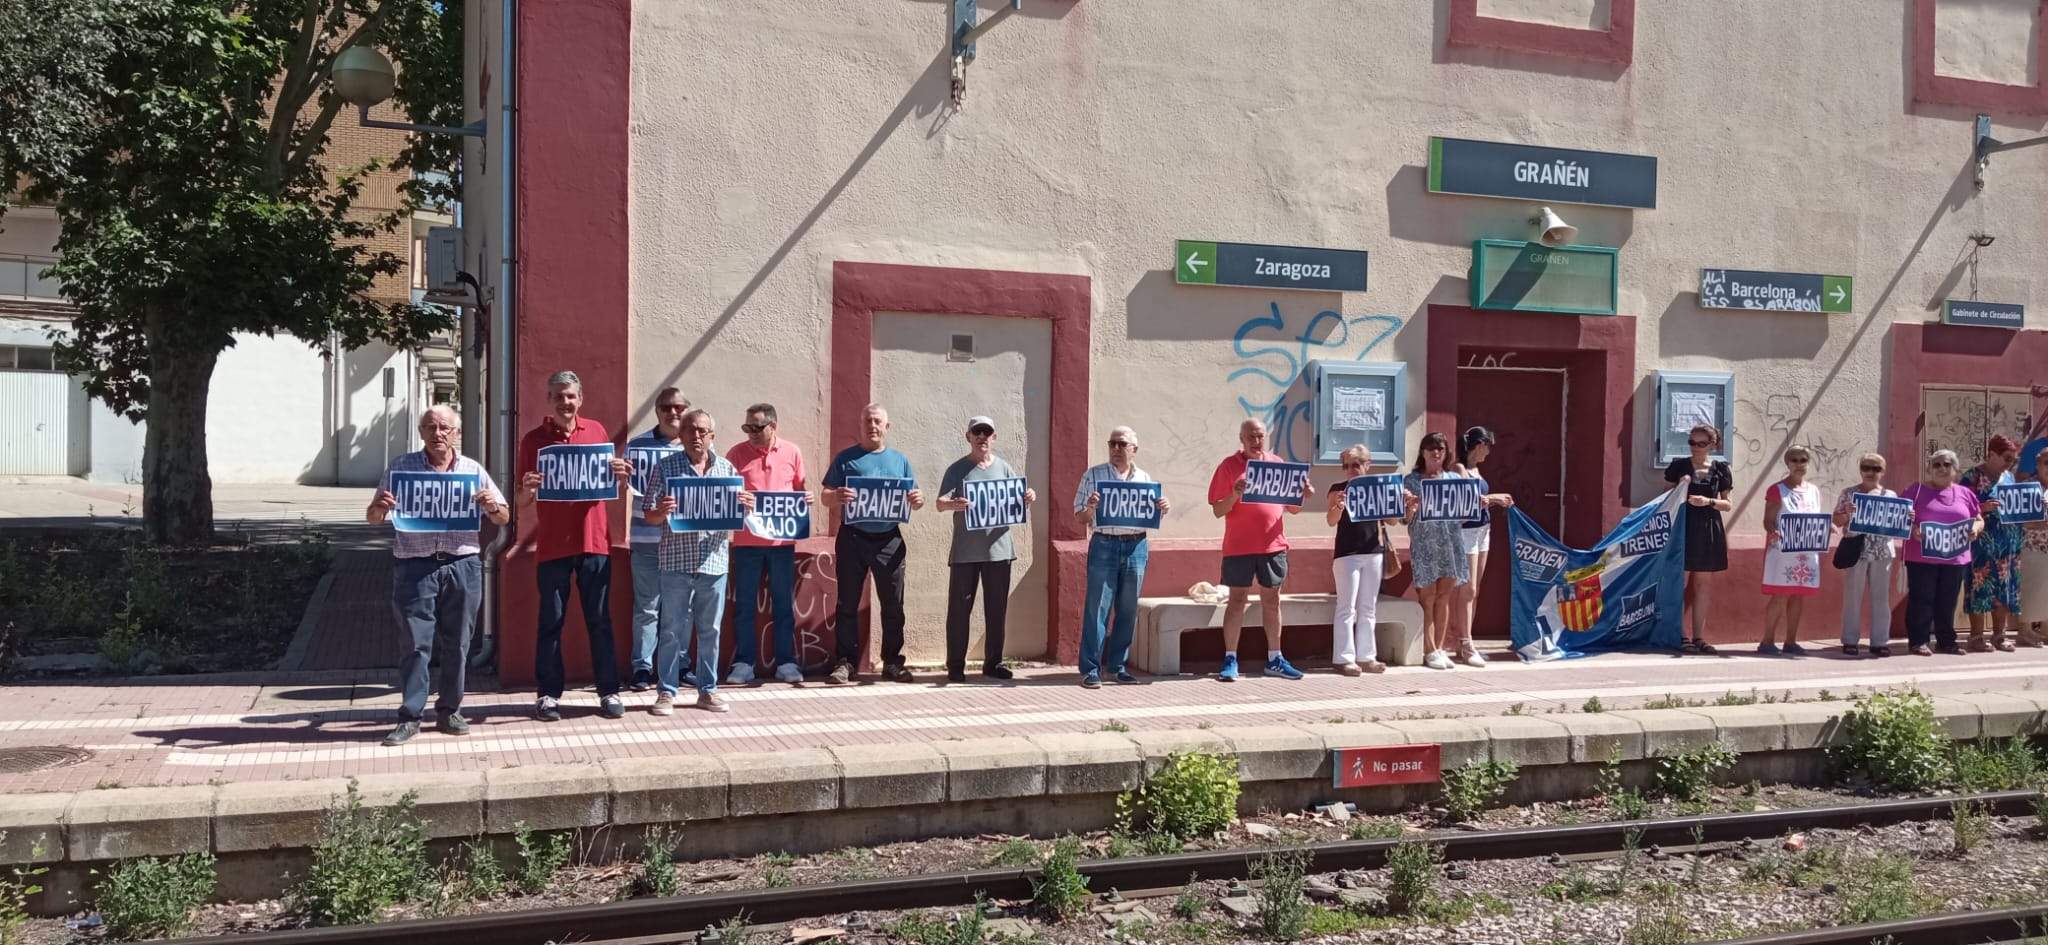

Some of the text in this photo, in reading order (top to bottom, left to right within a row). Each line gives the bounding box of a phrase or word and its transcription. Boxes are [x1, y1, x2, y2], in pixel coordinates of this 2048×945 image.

[1514, 159, 1589, 187] GRAÑÉN
[1255, 257, 1331, 280] Zaragoza
[1731, 282, 1796, 299] Barcelona
[1952, 308, 2021, 320] Gabinete de Circulación
[539, 452, 614, 491] TRAMACED
[1246, 466, 1307, 499] BARBUES
[394, 479, 477, 519] ALBERUELA
[671, 485, 743, 520] ALMUNIENTE
[753, 496, 808, 517] LBERO
[966, 479, 1024, 527] ROBRES
[1102, 487, 1154, 520] TORRES
[1421, 482, 1481, 518] VALFONDA
[1999, 487, 2042, 516] SODETO
[757, 516, 797, 537] BAJO
[1852, 497, 1911, 531] ALCUBIERRE
[1623, 532, 1670, 554] TRENES
[1779, 518, 1829, 549] SANGARREN
[1925, 523, 1969, 552] ROBRES
[1373, 761, 1423, 774] No pasar
